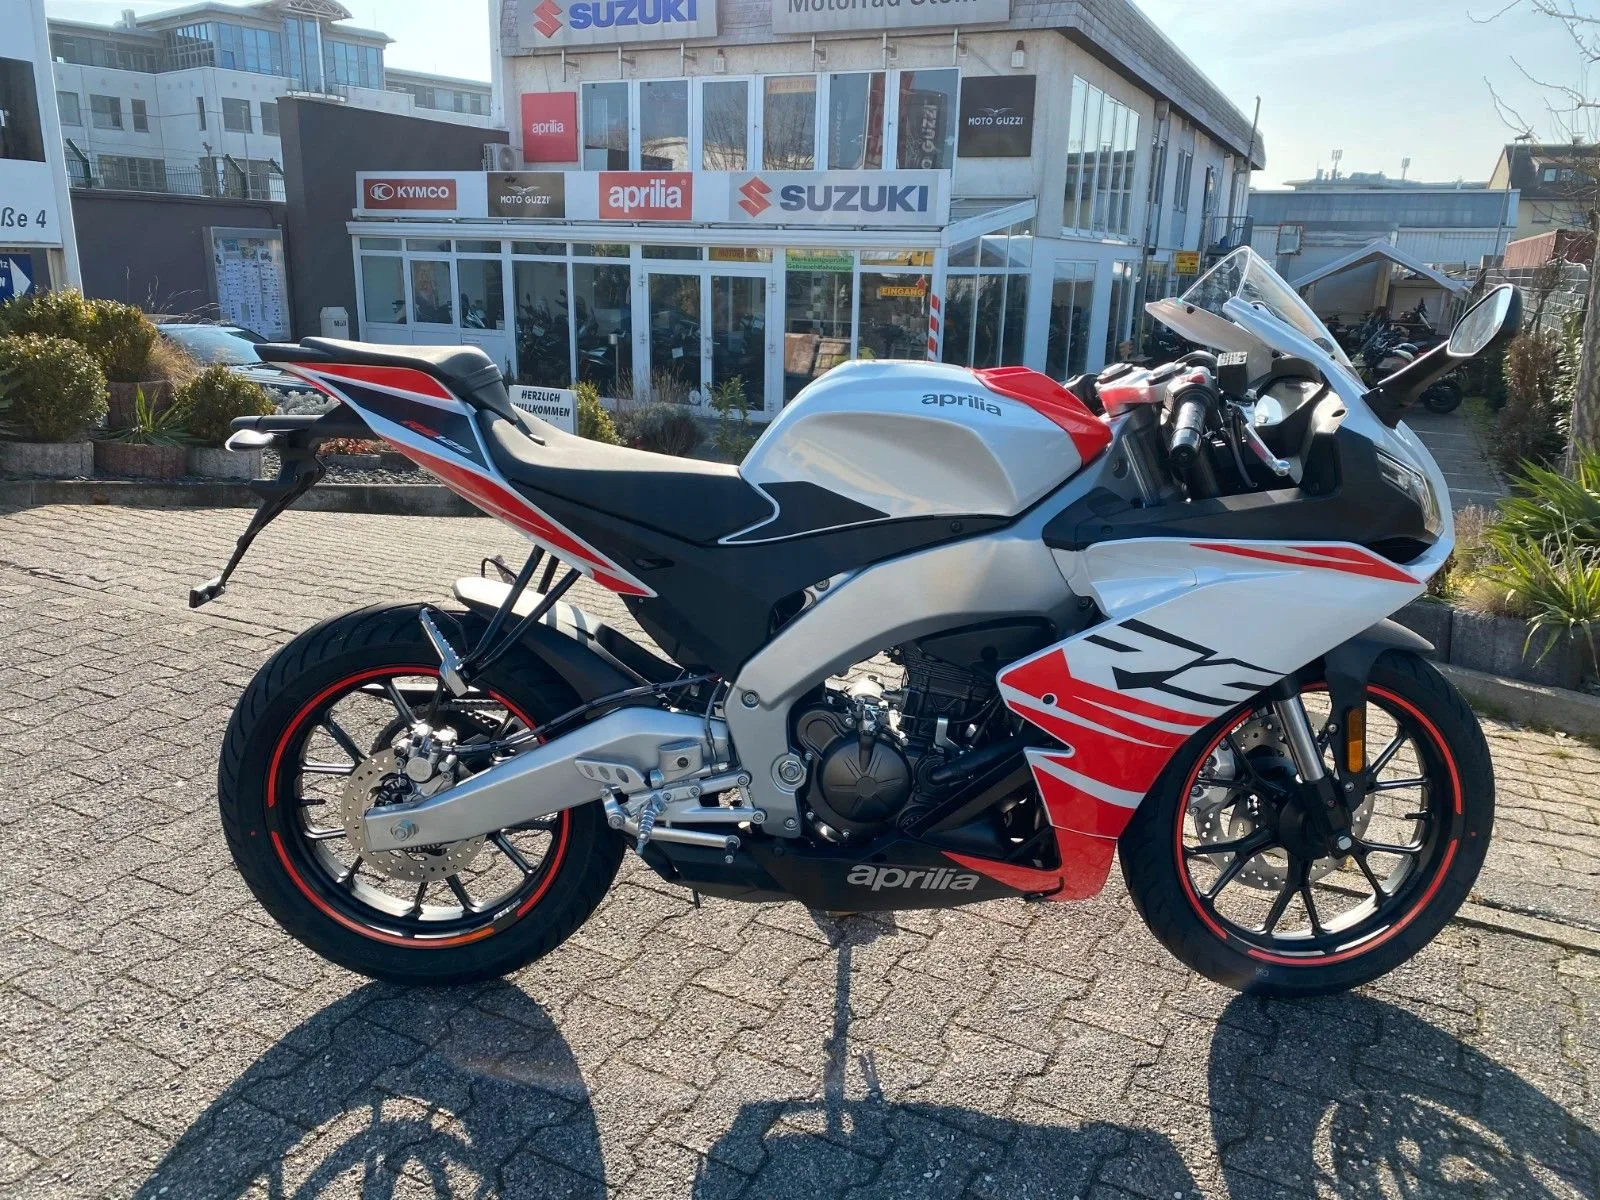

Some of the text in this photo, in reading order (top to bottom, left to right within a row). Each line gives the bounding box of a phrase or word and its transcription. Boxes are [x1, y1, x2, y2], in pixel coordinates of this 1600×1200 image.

[568, 0, 697, 30] SUZUKI
[532, 120, 564, 136] aprilia
[968, 117, 1024, 126] MOTO GUZZI
[397, 186, 449, 199] KYMCO
[500, 195, 551, 204] MOTO GUZZI
[608, 178, 682, 213] aprilia
[779, 184, 929, 213] SUZUKI
[36, 209, 47, 229] 4
[882, 287, 925, 296] EINGANG
[521, 390, 560, 403] HERZLICH
[921, 393, 1002, 417] aprilia
[846, 865, 980, 892] aprilia
